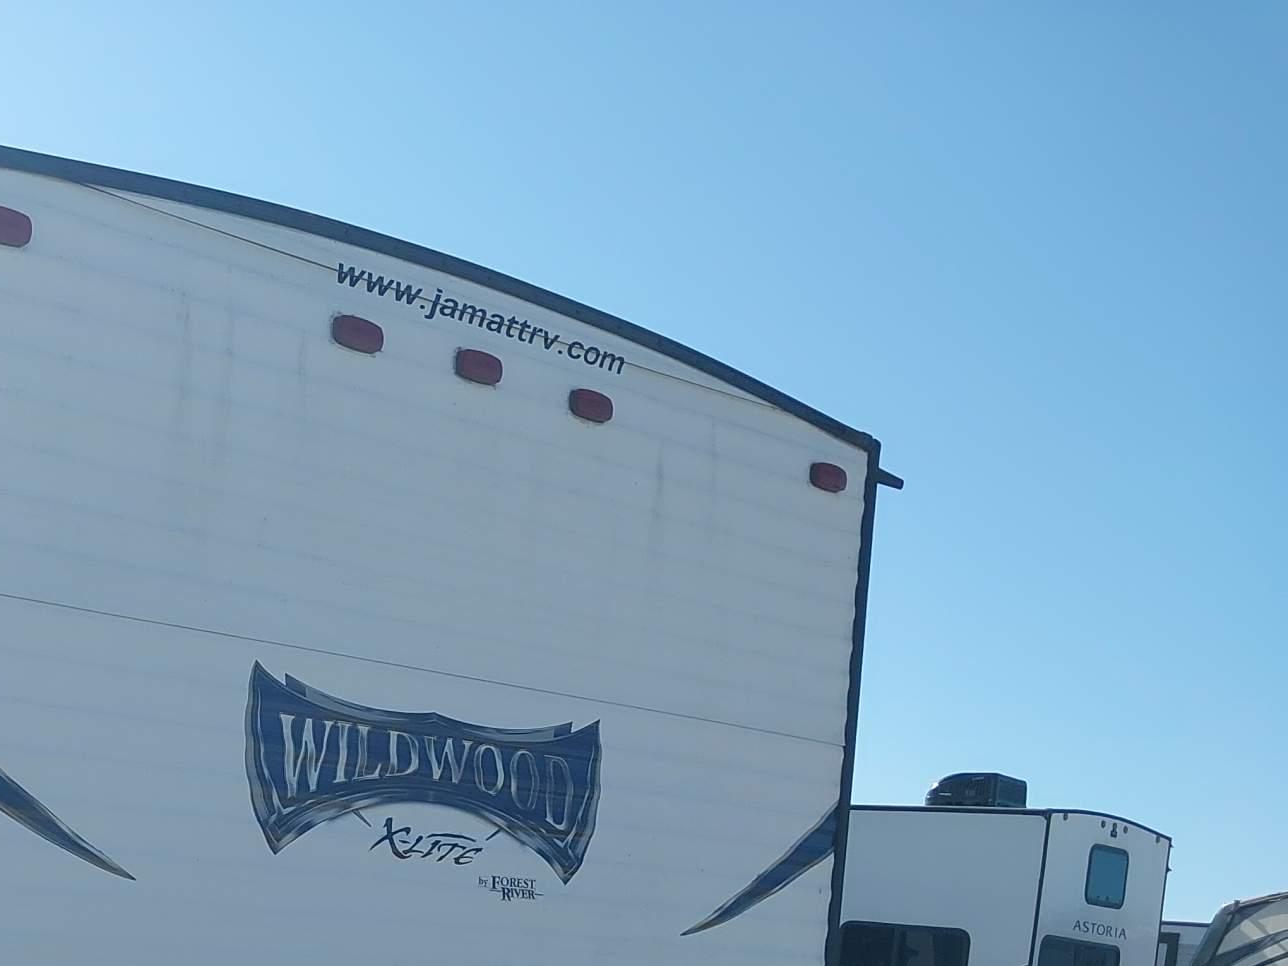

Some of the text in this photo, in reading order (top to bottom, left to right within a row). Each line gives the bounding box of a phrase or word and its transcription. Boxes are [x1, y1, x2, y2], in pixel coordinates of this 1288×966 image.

[336, 261, 625, 375] www.jamattrv.com
[279, 712, 574, 831] WILDWOOD
[478, 875, 537, 889] by FOREST
[501, 886, 536, 902] RIVER
[1072, 919, 1127, 941] ASTORIA
